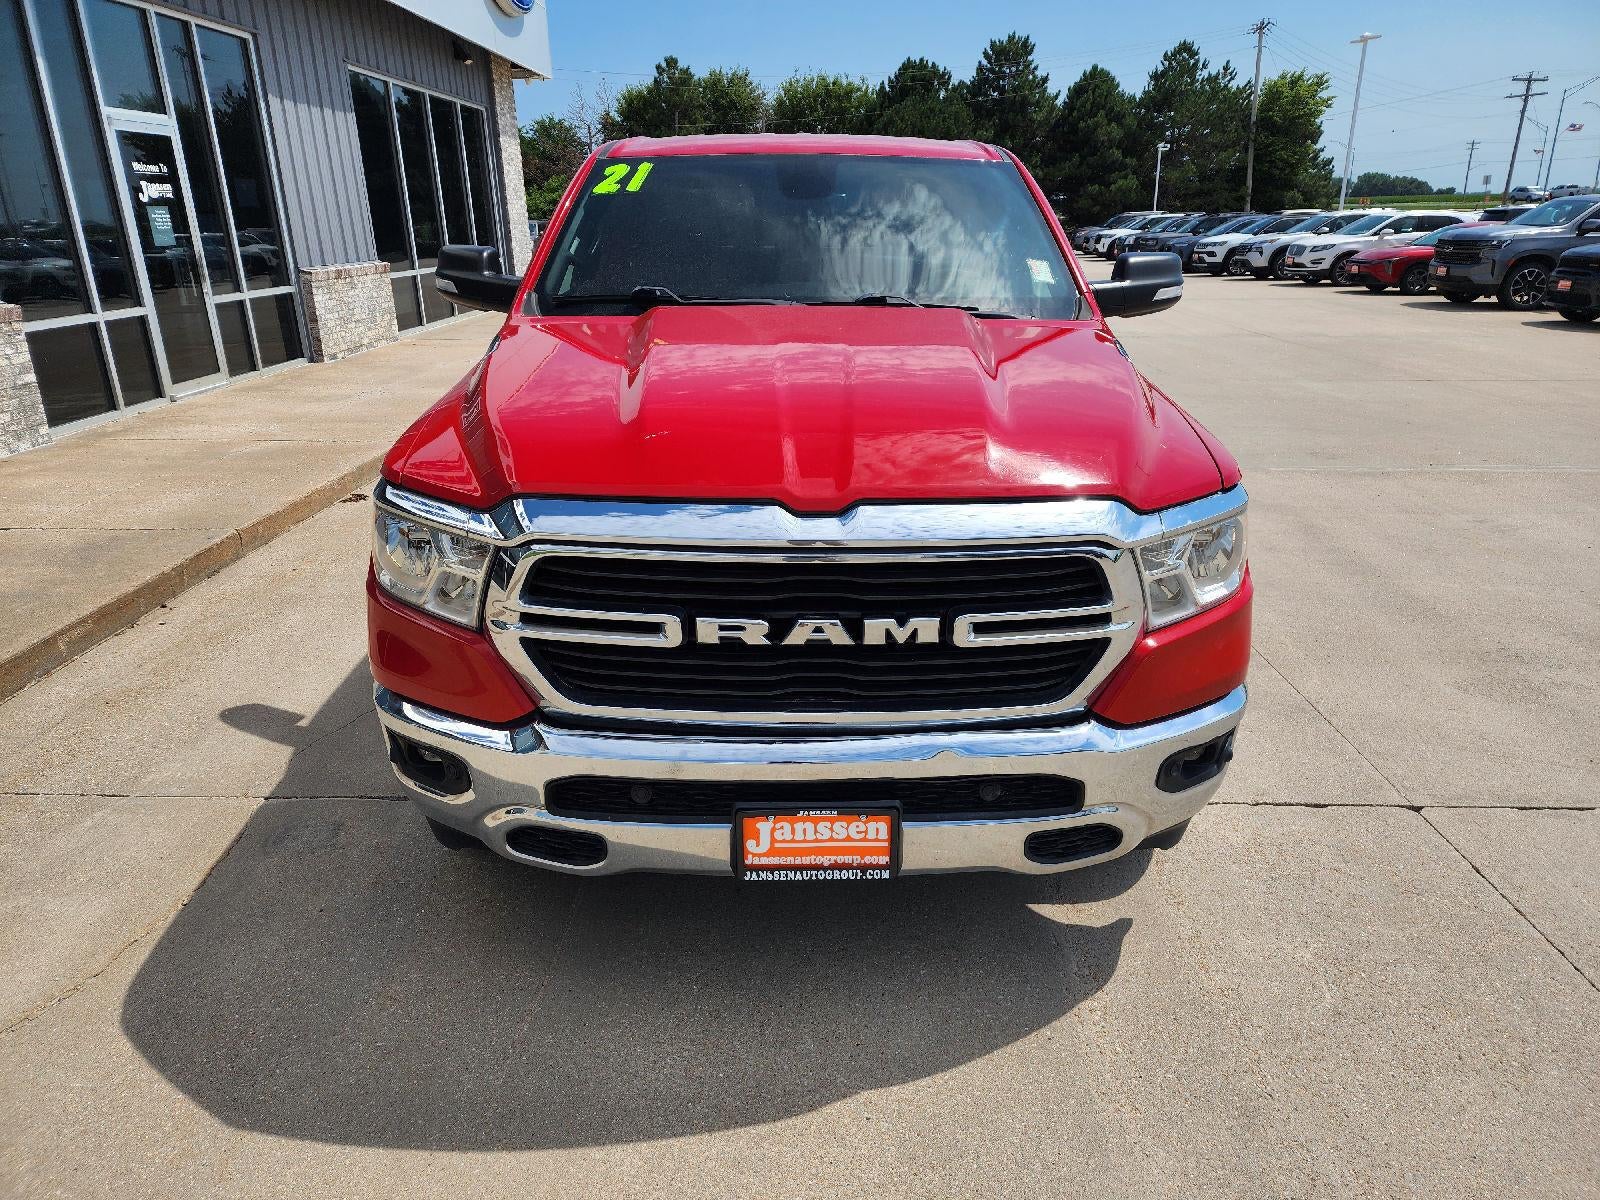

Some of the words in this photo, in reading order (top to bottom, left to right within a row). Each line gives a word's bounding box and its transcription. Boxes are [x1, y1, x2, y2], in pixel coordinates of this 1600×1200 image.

[131, 161, 160, 172] Welcome
[159, 163, 168, 173] To
[592, 162, 654, 194] 21
[696, 617, 941, 645] RAM
[745, 820, 889, 854] Janssen
[745, 854, 890, 867] Janssenautogroup.com
[743, 869, 890, 881] JANSSENAUTOGROUP.COM
